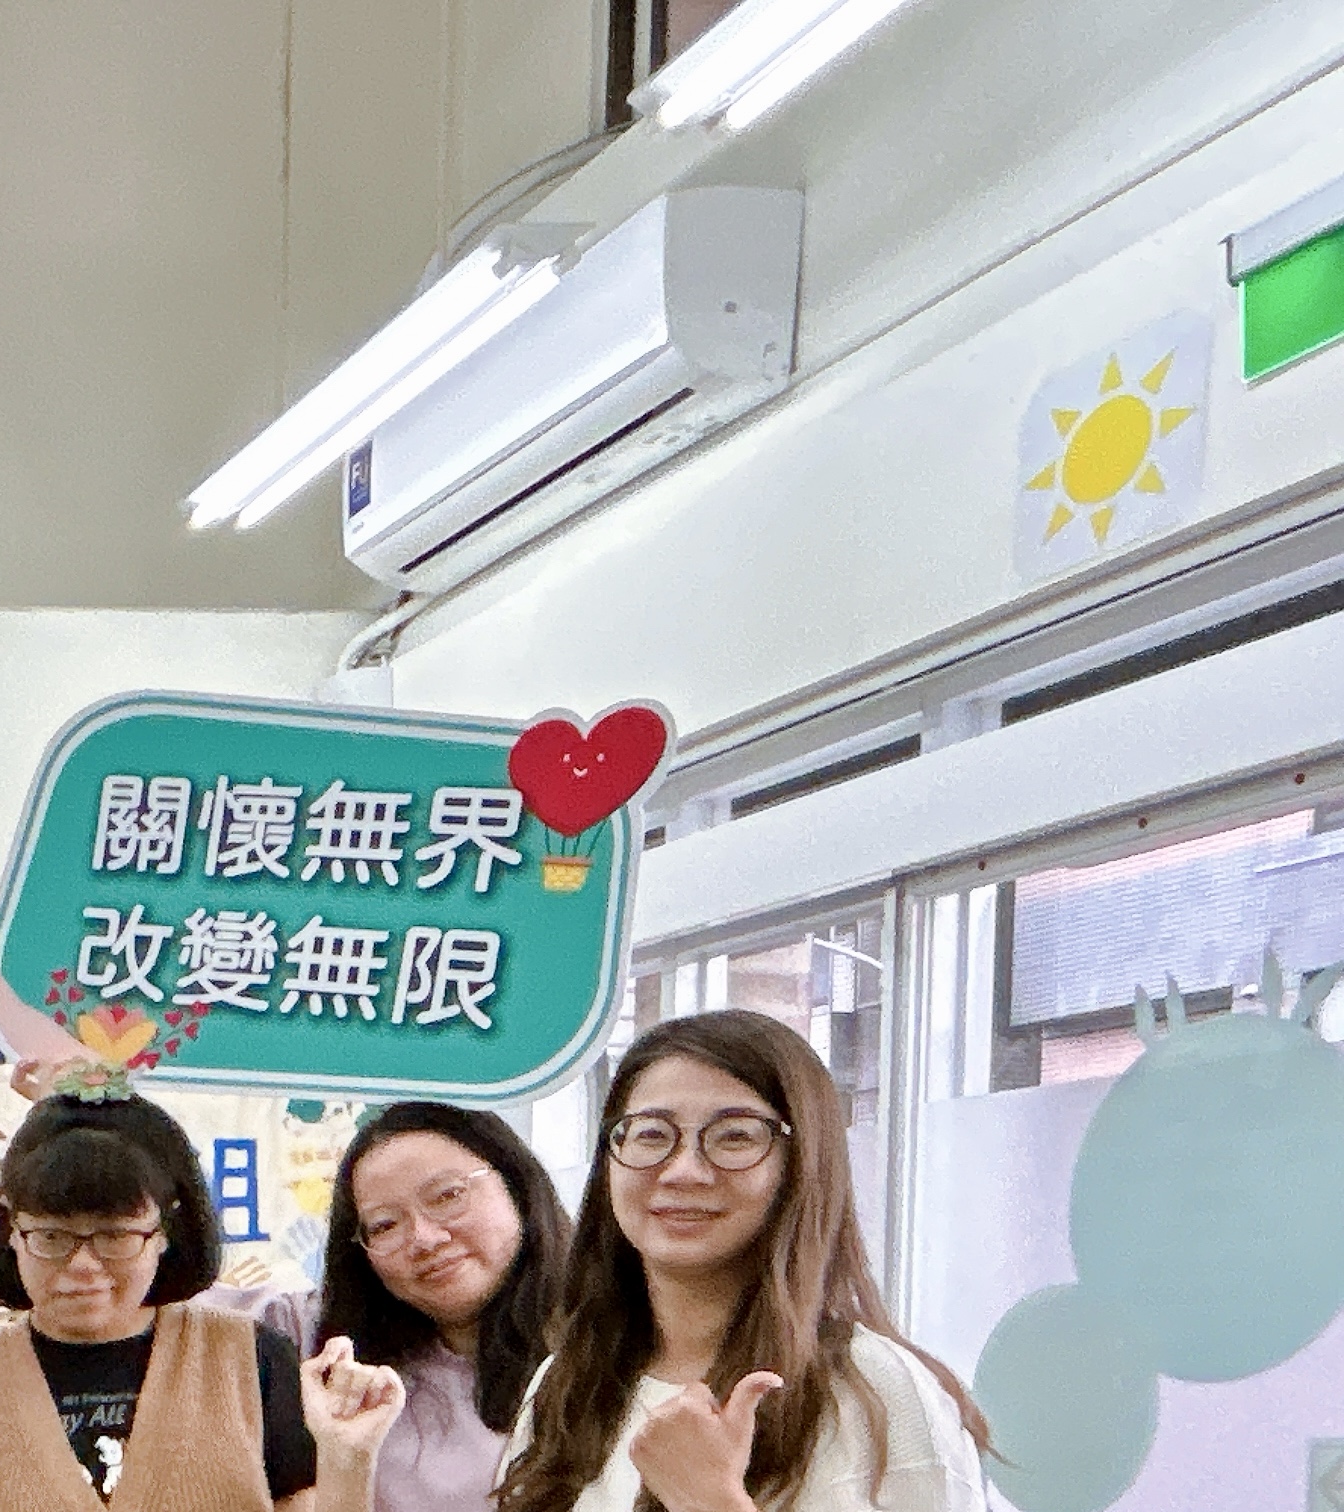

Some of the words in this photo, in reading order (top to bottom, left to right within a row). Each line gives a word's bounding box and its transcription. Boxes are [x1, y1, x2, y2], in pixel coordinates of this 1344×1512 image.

[90, 773, 524, 893] 關懷無界
[75, 903, 502, 1031] 改變無限
